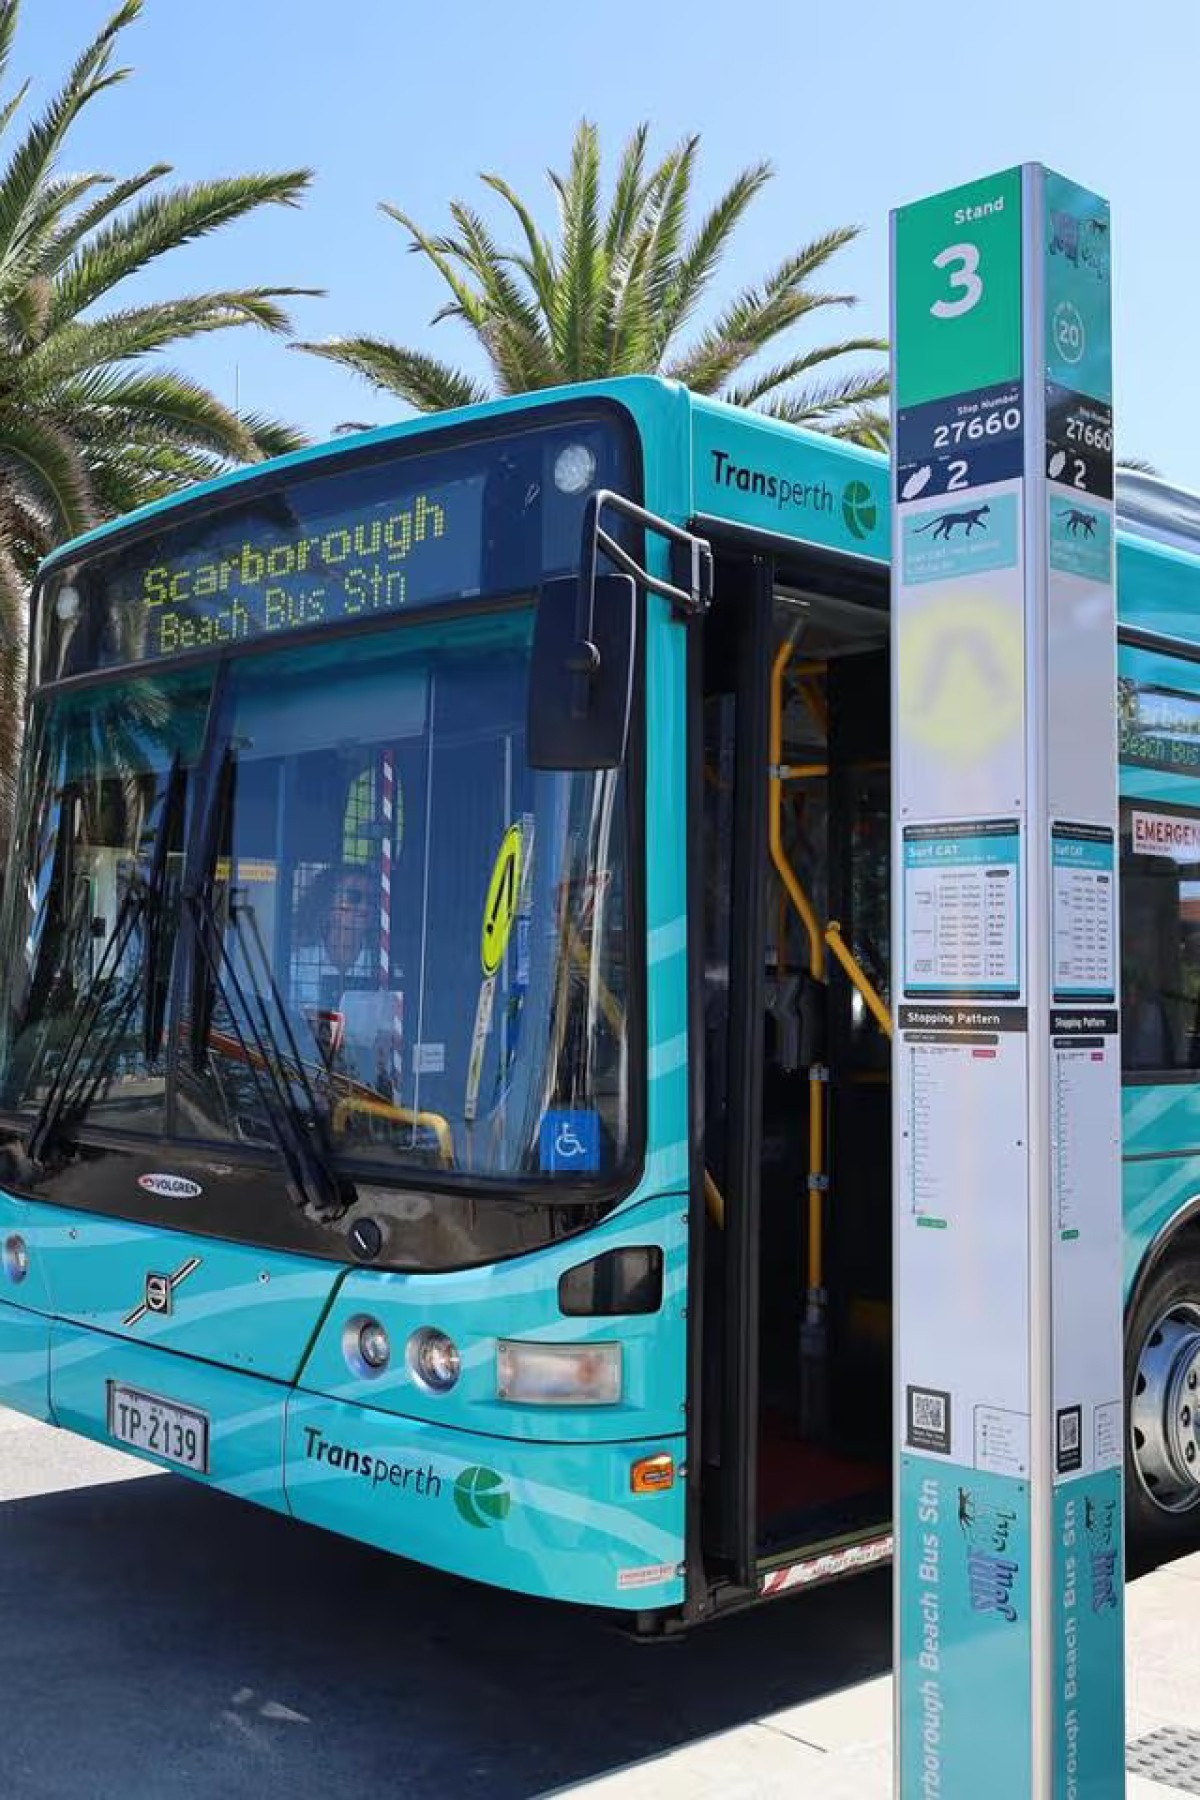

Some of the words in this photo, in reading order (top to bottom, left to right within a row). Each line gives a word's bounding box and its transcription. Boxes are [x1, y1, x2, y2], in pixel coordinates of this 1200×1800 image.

[953, 196, 1005, 225] Stand
[929, 243, 983, 319] 3
[933, 408, 1020, 449] 27660
[1066, 416, 1113, 453] 27660
[711, 450, 833, 514] Transperth
[947, 460, 969, 490] 2
[1073, 458, 1087, 490] 2
[142, 495, 445, 607] Scarborough
[159, 597, 250, 653] Beach
[265, 587, 325, 631] Bus
[344, 564, 406, 614] Stn
[907, 1011, 954, 1025] Stopping
[957, 1011, 1000, 1025] Pattern
[154, 1178, 198, 1194] VOLGREN
[304, 1426, 442, 1498] Transperth
[918, 1480, 940, 1524] Stn
[918, 1533, 940, 1584] Bus
[1063, 1556, 1077, 1608] Bus
[918, 1590, 940, 1671] Beach
[1064, 1617, 1078, 1700] Beach
[919, 1680, 943, 1800] rborough
